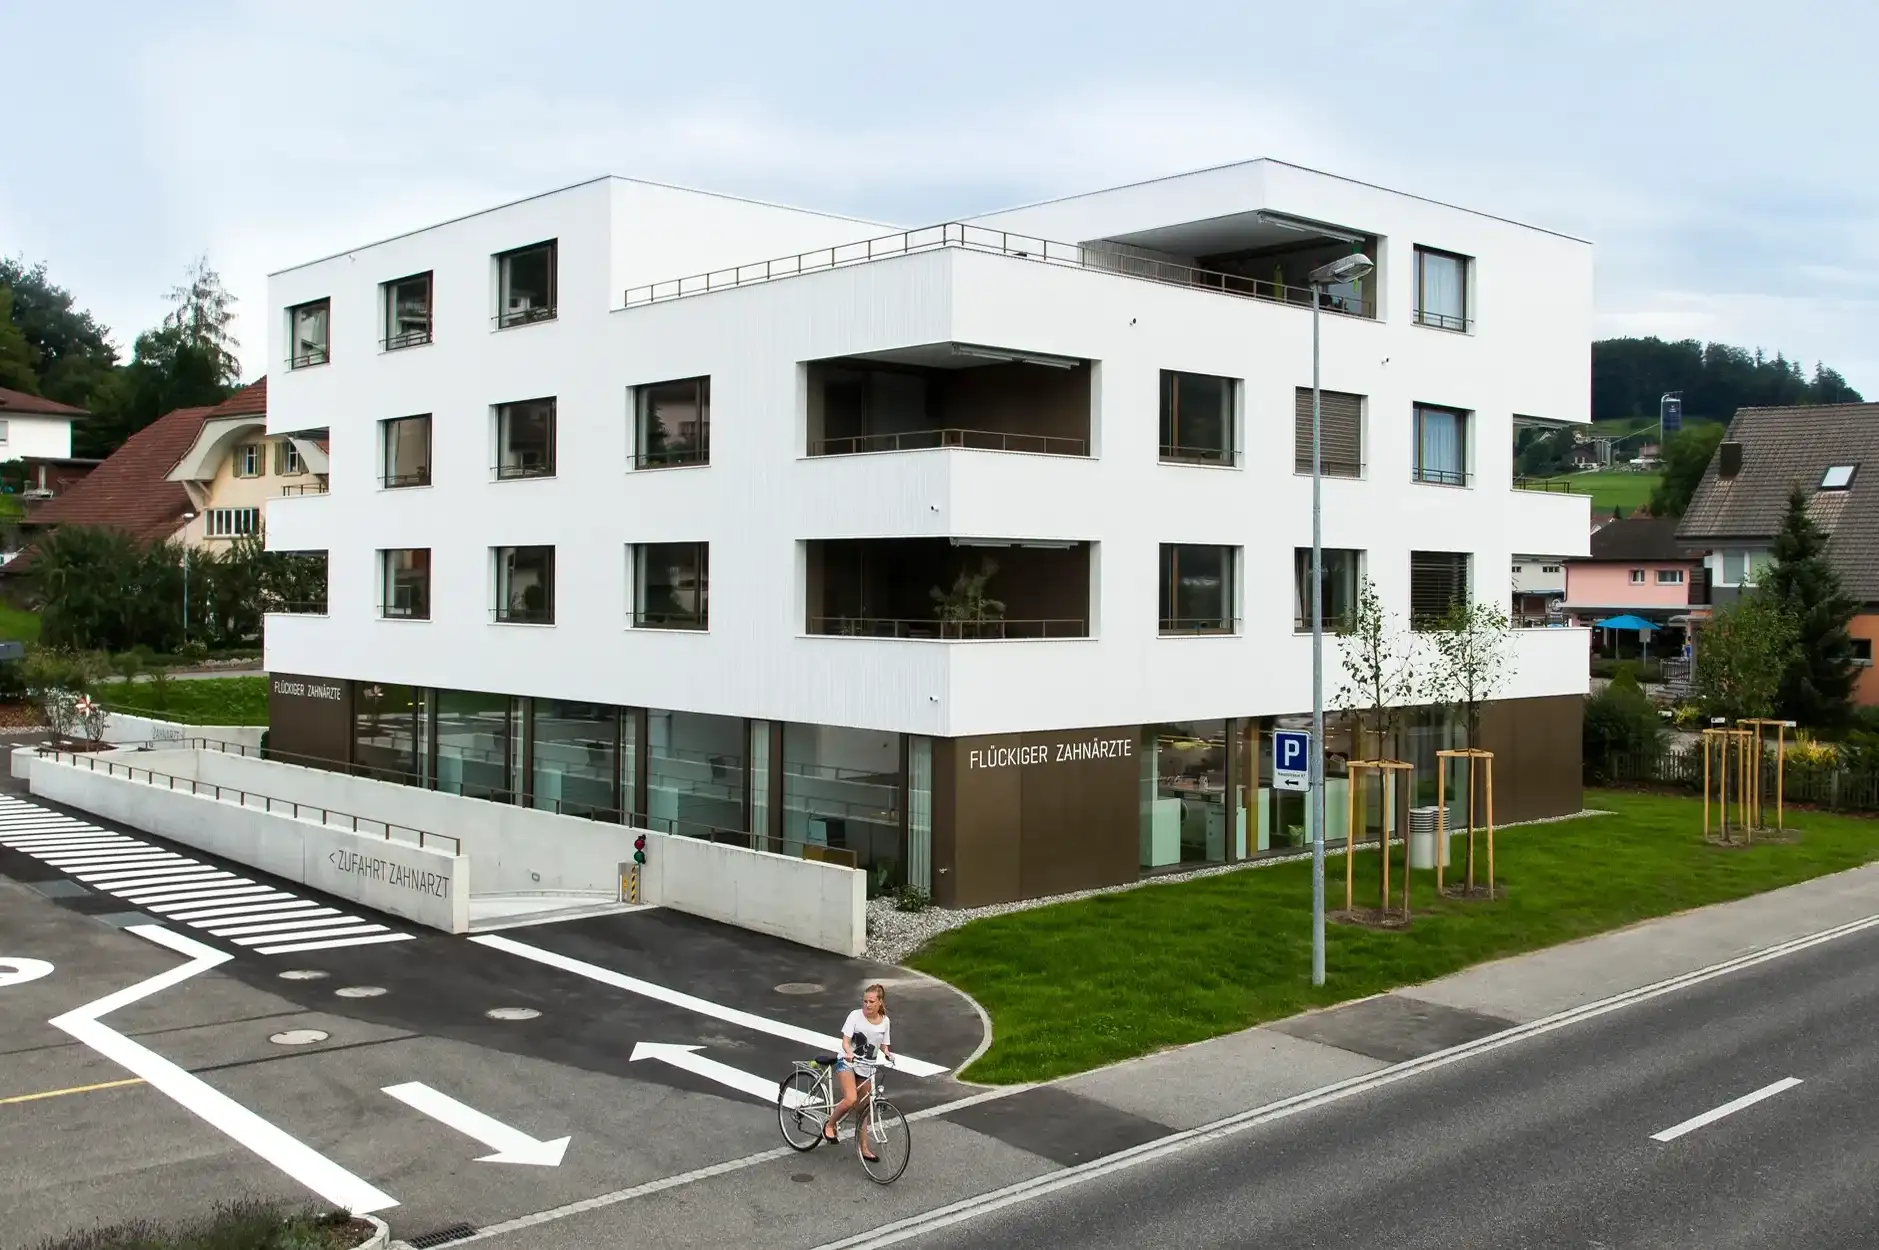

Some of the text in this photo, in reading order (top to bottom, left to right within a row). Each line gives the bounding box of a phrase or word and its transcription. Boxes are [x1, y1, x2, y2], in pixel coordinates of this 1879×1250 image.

[274, 680, 341, 701] FLÜCKIGER ZAHNÄRZTE
[970, 737, 1132, 769] FLÜCKIGER ZAHNÄRZTE
[1284, 739, 1300, 766] P
[338, 849, 450, 899] ZUFAHRT ZAHNARZT
